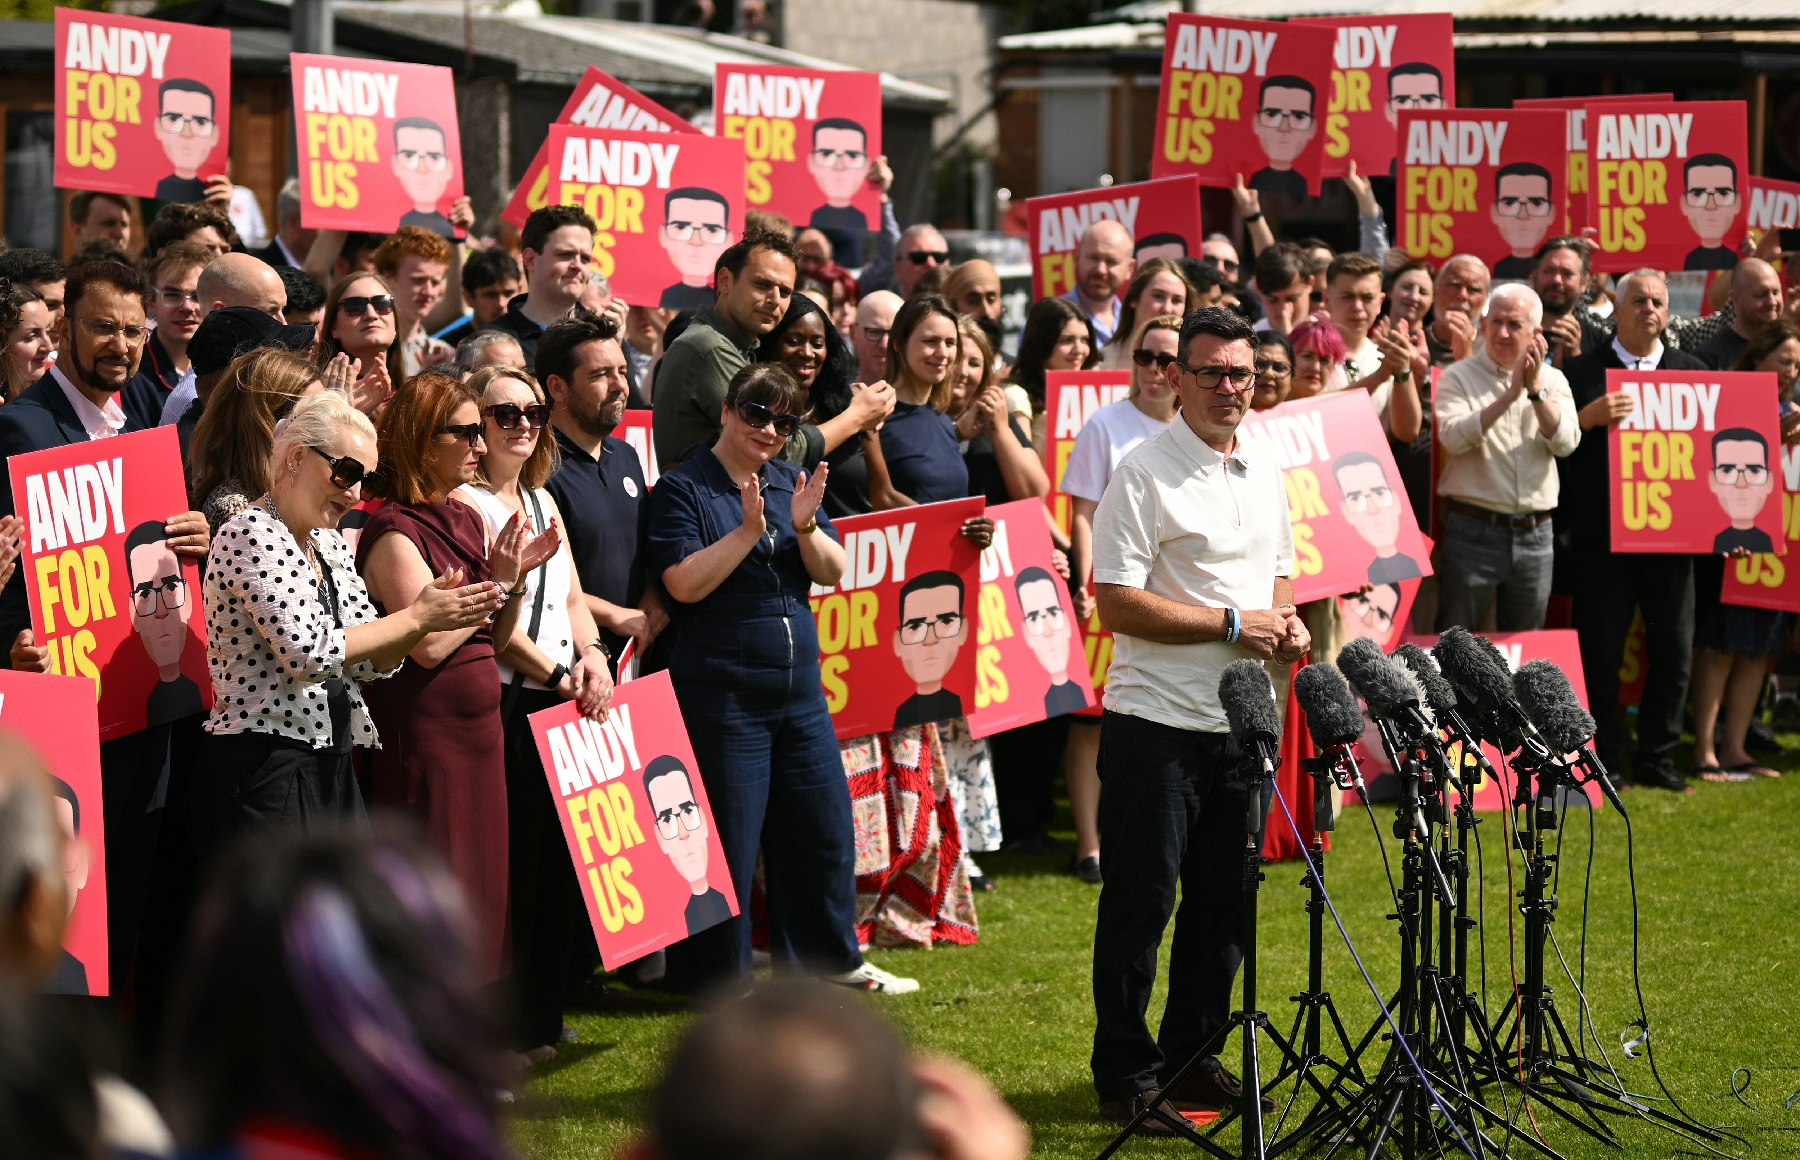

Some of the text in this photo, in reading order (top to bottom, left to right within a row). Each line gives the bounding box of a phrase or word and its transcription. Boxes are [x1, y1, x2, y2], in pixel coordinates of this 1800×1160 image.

[65, 22, 171, 79] ANDY
[1171, 24, 1277, 76] ANDY
[1333, 25, 1398, 69] NDY
[66, 71, 141, 124] FOR
[304, 66, 399, 118] ANDY
[570, 82, 673, 132] AN
[723, 73, 824, 119] ANDY
[1167, 71, 1243, 120] FOR
[1328, 70, 1372, 113] OR
[66, 118, 117, 170] US
[307, 114, 379, 163] FOR
[1163, 117, 1216, 164] US
[1324, 113, 1350, 158] S
[1405, 120, 1508, 166] ANDY
[1596, 113, 1694, 159] ANDY
[310, 161, 360, 209] US
[560, 137, 680, 189] ANDY
[746, 160, 773, 204] S
[1598, 160, 1667, 206] FOR
[1405, 166, 1478, 213] FOR
[1748, 187, 1800, 230] ND
[592, 231, 617, 278] S
[1406, 212, 1454, 258] US
[1599, 207, 1646, 253] US
[1055, 385, 1130, 439] AN
[1619, 383, 1720, 431] ANDY
[1240, 411, 1331, 469] NDY
[1621, 431, 1695, 481] FOR
[25, 457, 126, 554] ANDY
[1282, 467, 1329, 523] OR
[1623, 481, 1672, 530] US
[809, 522, 916, 597] NDY
[980, 519, 1014, 583] DY
[1290, 522, 1323, 580] S
[1736, 545, 1787, 588] US
[35, 544, 116, 633] FOR
[977, 582, 1014, 645] OR
[809, 590, 879, 655] OR
[818, 654, 850, 724] S
[546, 704, 642, 796] ANDY
[566, 781, 645, 863] FOR
[587, 855, 644, 933] US
